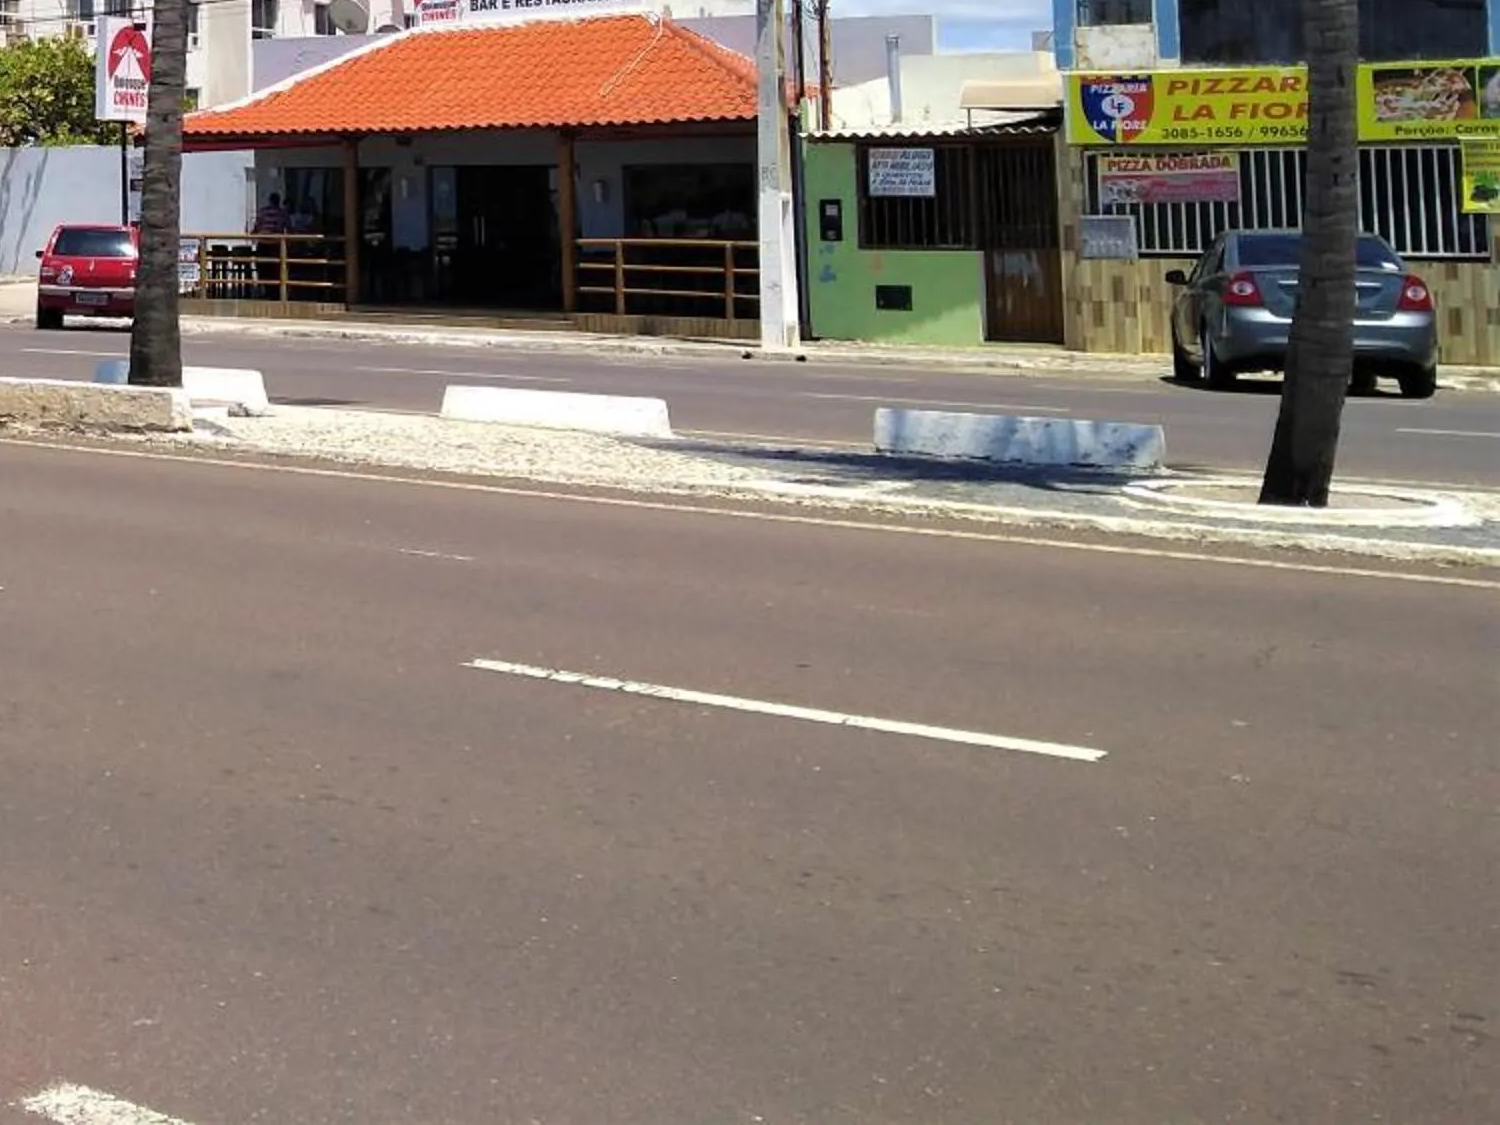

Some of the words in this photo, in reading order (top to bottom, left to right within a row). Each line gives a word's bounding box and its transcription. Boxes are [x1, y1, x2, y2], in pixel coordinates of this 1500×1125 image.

[1167, 76, 1308, 96] PIZZAR
[1173, 103, 1217, 122] LA
[1229, 102, 1311, 120] FIOR
[1093, 121, 1108, 131] LA
[1162, 126, 1243, 139] 3085-1656
[1259, 125, 1309, 138] 99656
[1107, 159, 1152, 172] PIZZA
[1156, 156, 1232, 172] DOBRADA
